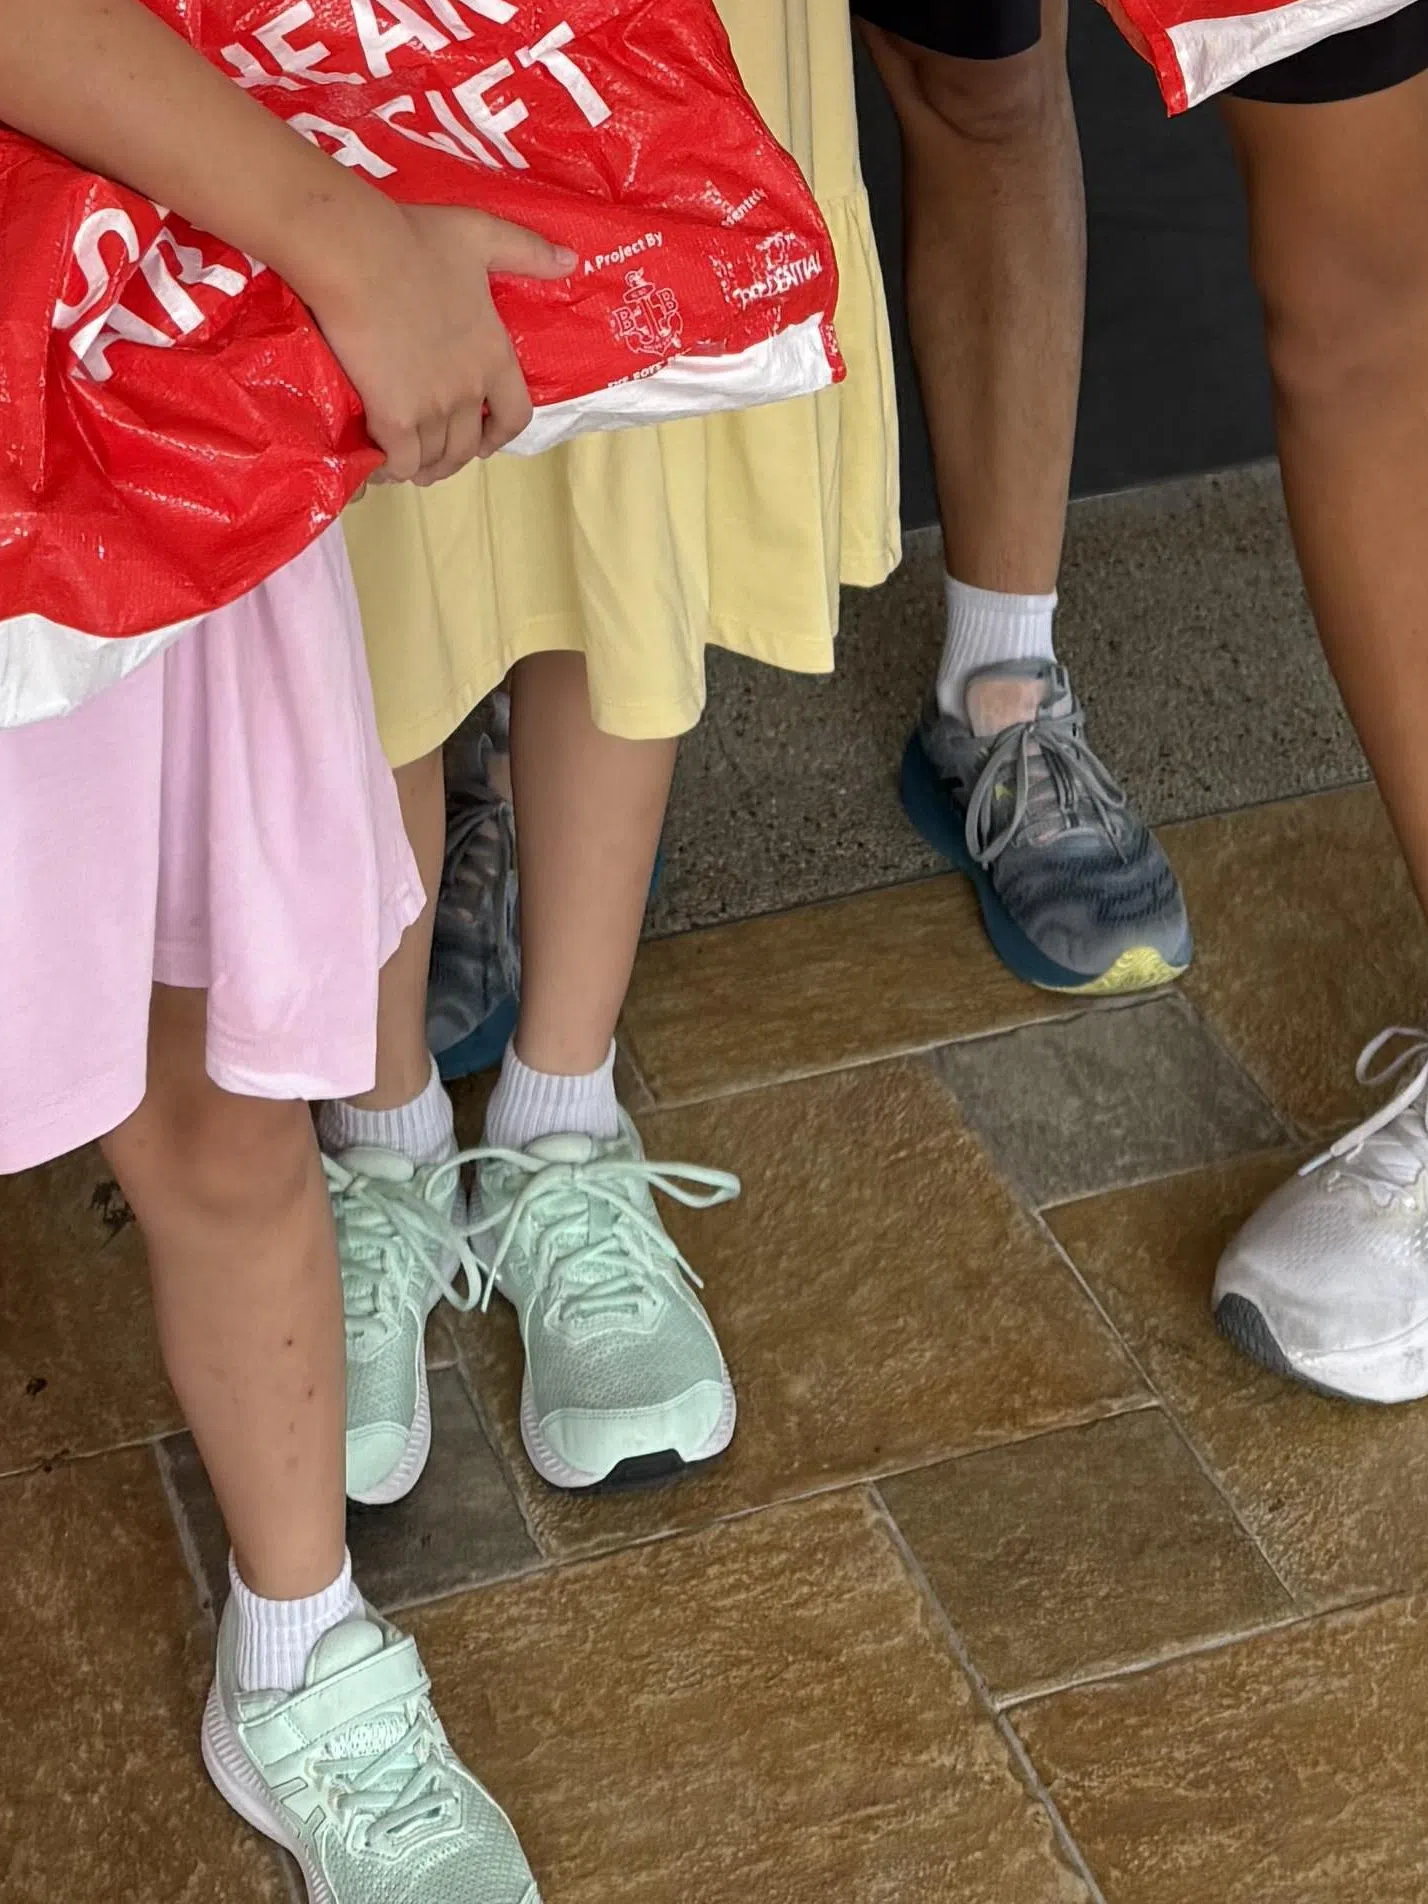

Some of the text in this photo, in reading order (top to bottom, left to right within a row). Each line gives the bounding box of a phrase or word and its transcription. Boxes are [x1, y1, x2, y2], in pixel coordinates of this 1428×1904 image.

[584, 231, 663, 276] A Project By
